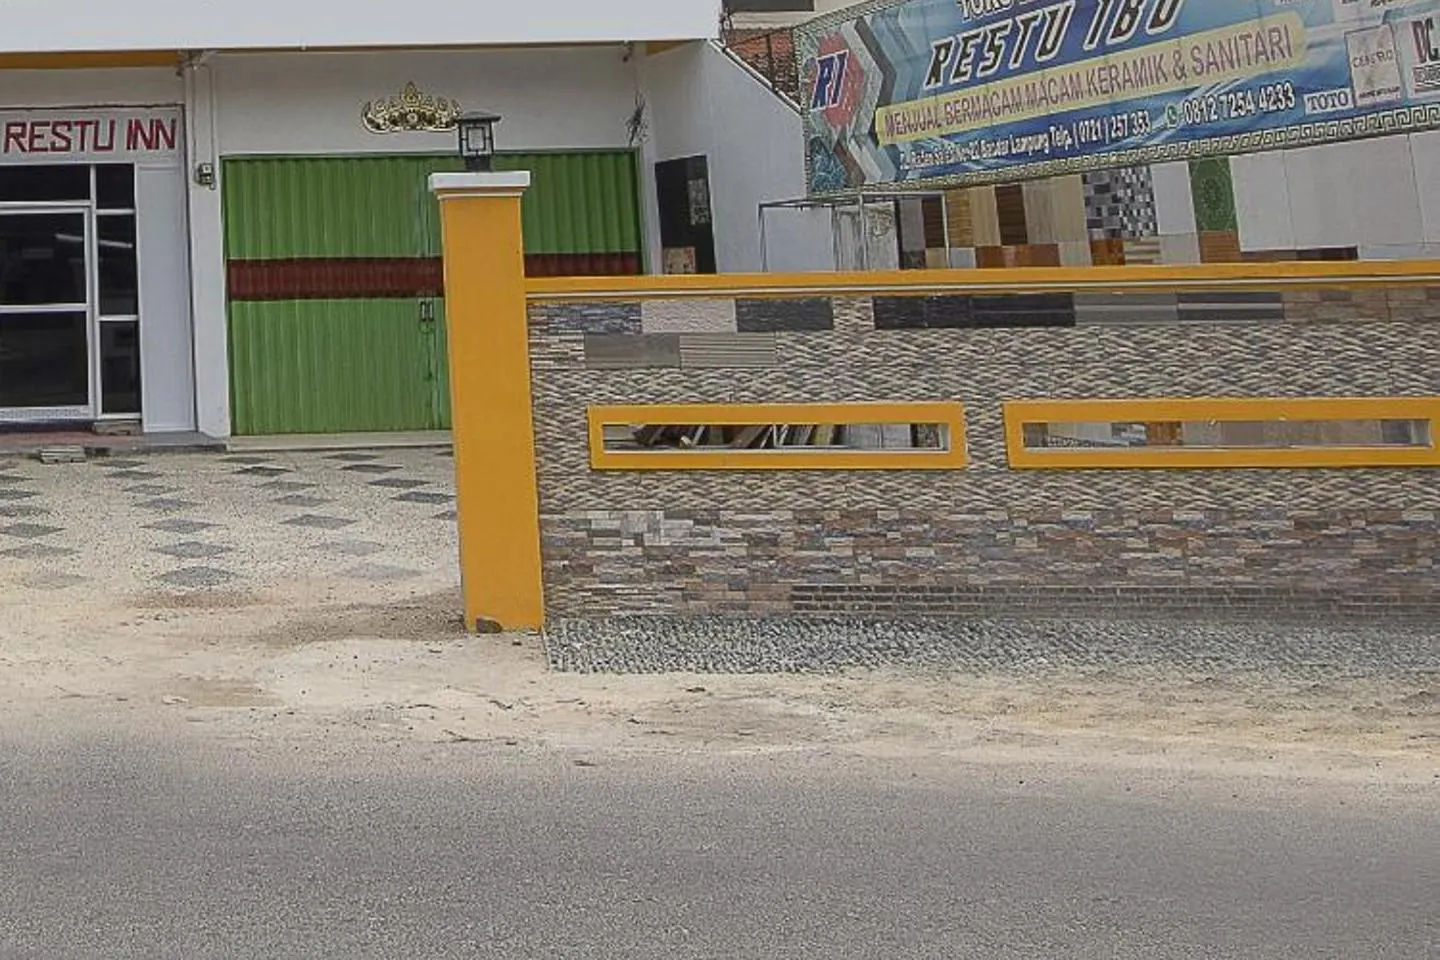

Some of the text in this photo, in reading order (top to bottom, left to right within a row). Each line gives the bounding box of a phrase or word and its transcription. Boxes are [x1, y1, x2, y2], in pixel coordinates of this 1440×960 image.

[1085, 51, 1168, 97] KERAMIK
[1172, 49, 1188, 82] &
[1190, 23, 1294, 77] SANITARI
[1182, 94, 1218, 126] 0812
[1258, 81, 1296, 115] 4233
[1307, 90, 1349, 112] TOTO
[2, 119, 116, 154] RESTU
[126, 117, 177, 152] INN
[1010, 131, 1050, 156] Lampung
